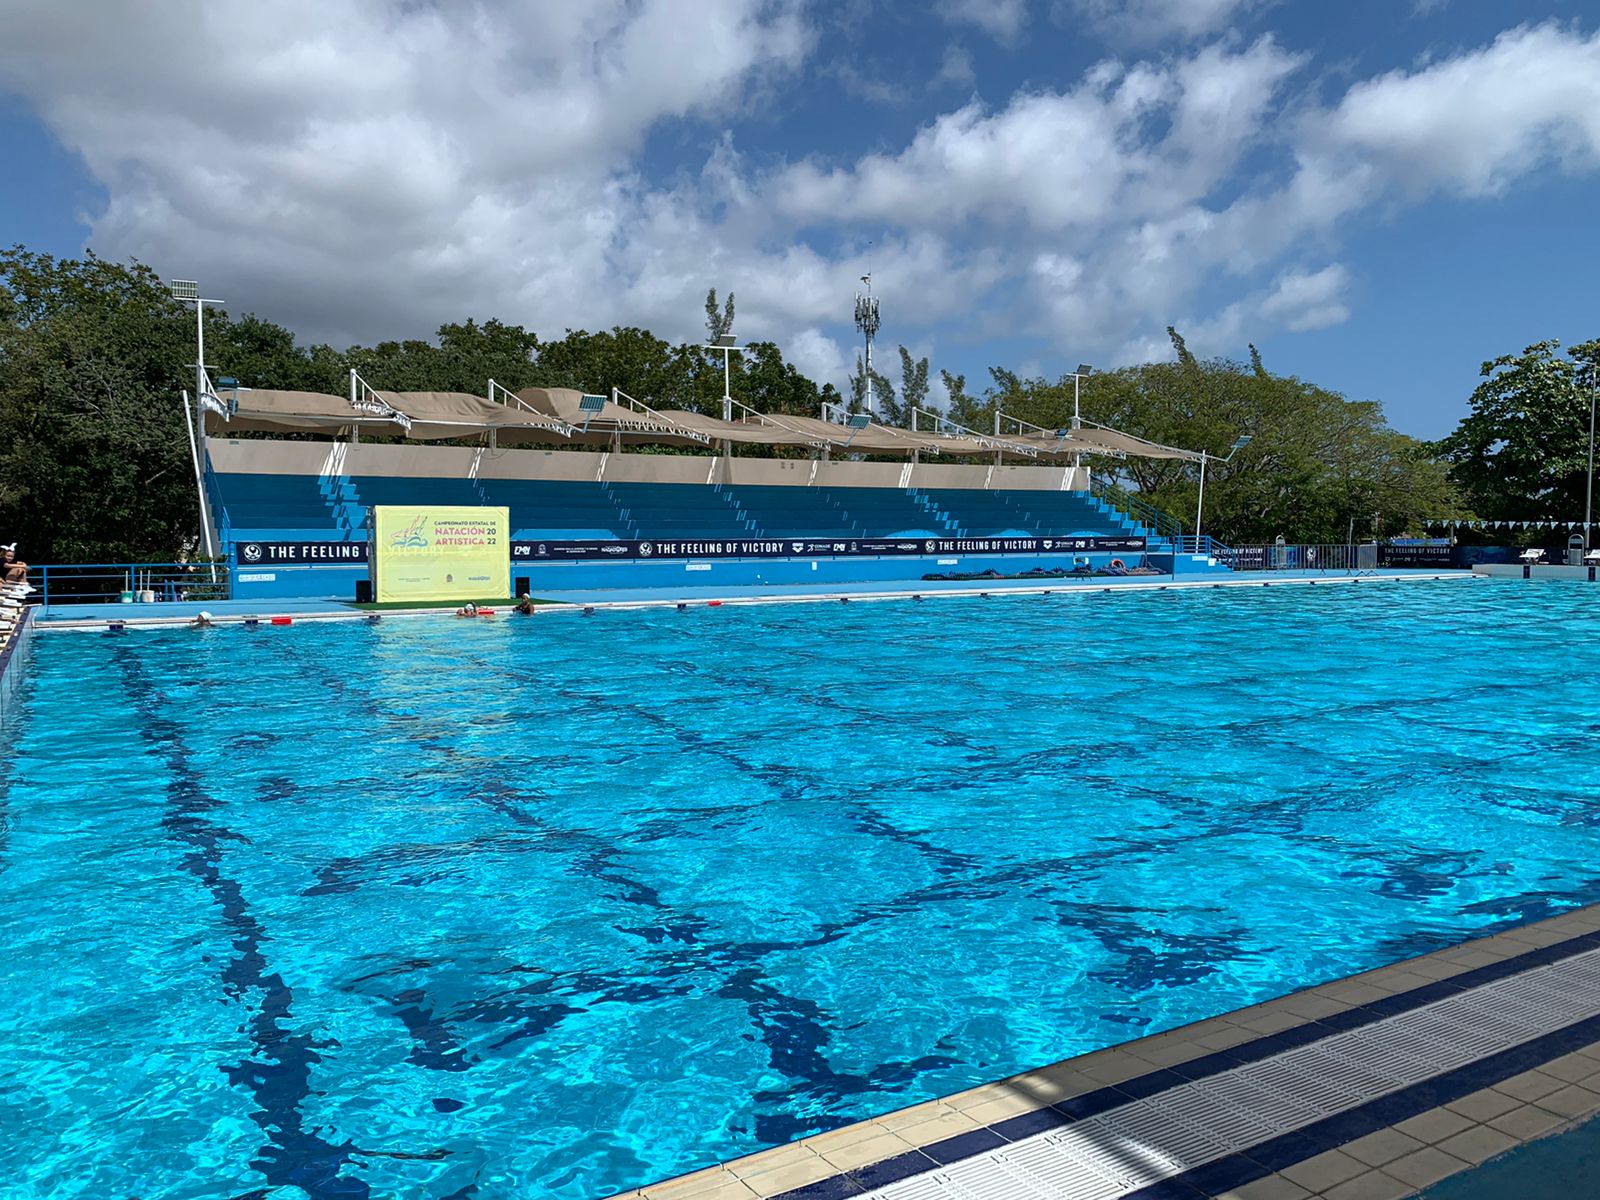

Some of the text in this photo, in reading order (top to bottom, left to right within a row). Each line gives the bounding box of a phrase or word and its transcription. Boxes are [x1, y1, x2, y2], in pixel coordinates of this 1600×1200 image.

[435, 526, 497, 536] NATACIÓN 20
[487, 537, 497, 546] 22
[938, 540, 1037, 551] THE FEELING OF VICTORY
[268, 545, 296, 558] THE
[302, 545, 360, 558] FEELING
[656, 542, 784, 554] THE FEELING OF VICTORY
